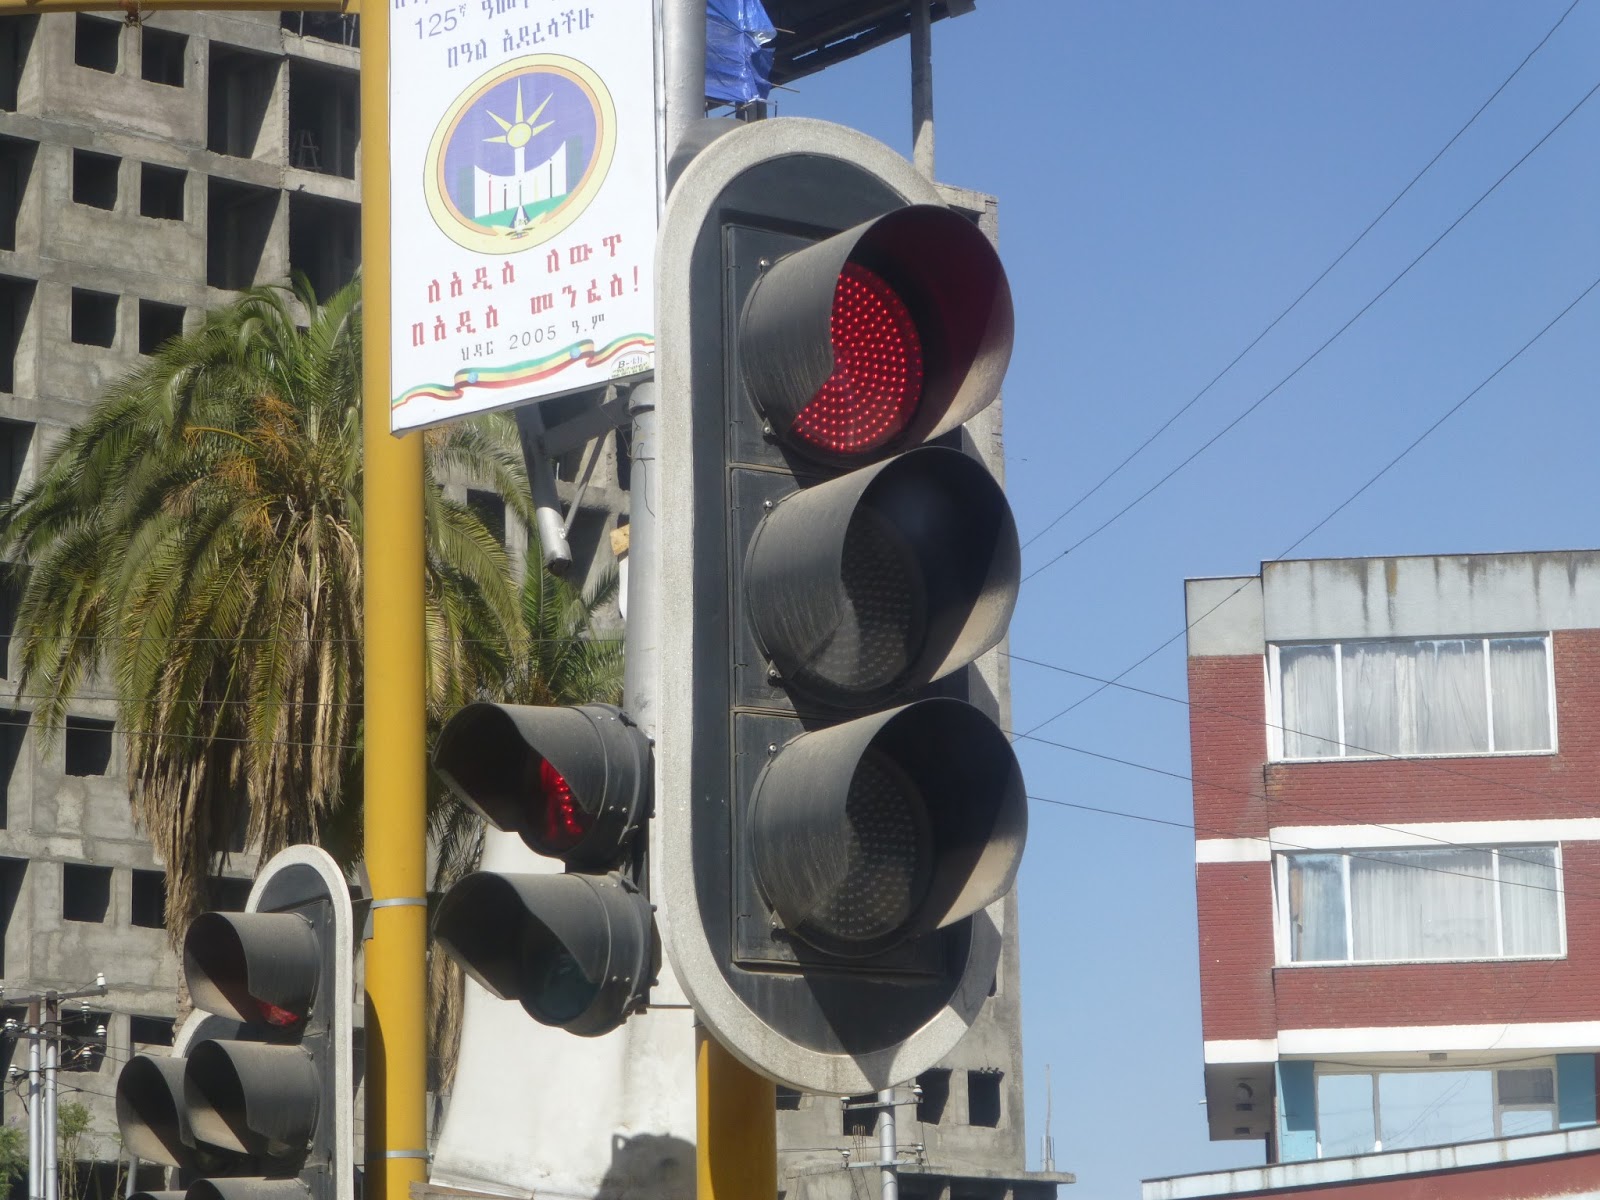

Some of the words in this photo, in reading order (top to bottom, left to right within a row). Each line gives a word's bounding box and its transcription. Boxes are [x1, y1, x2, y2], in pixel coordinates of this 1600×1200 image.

[447, 38, 488, 68] በዓል
[428, 260, 515, 303] ለአዲስ
[412, 304, 499, 347] በአዲስ
[530, 265, 639, 315] መንፈስ!
[509, 325, 556, 350] 2005
